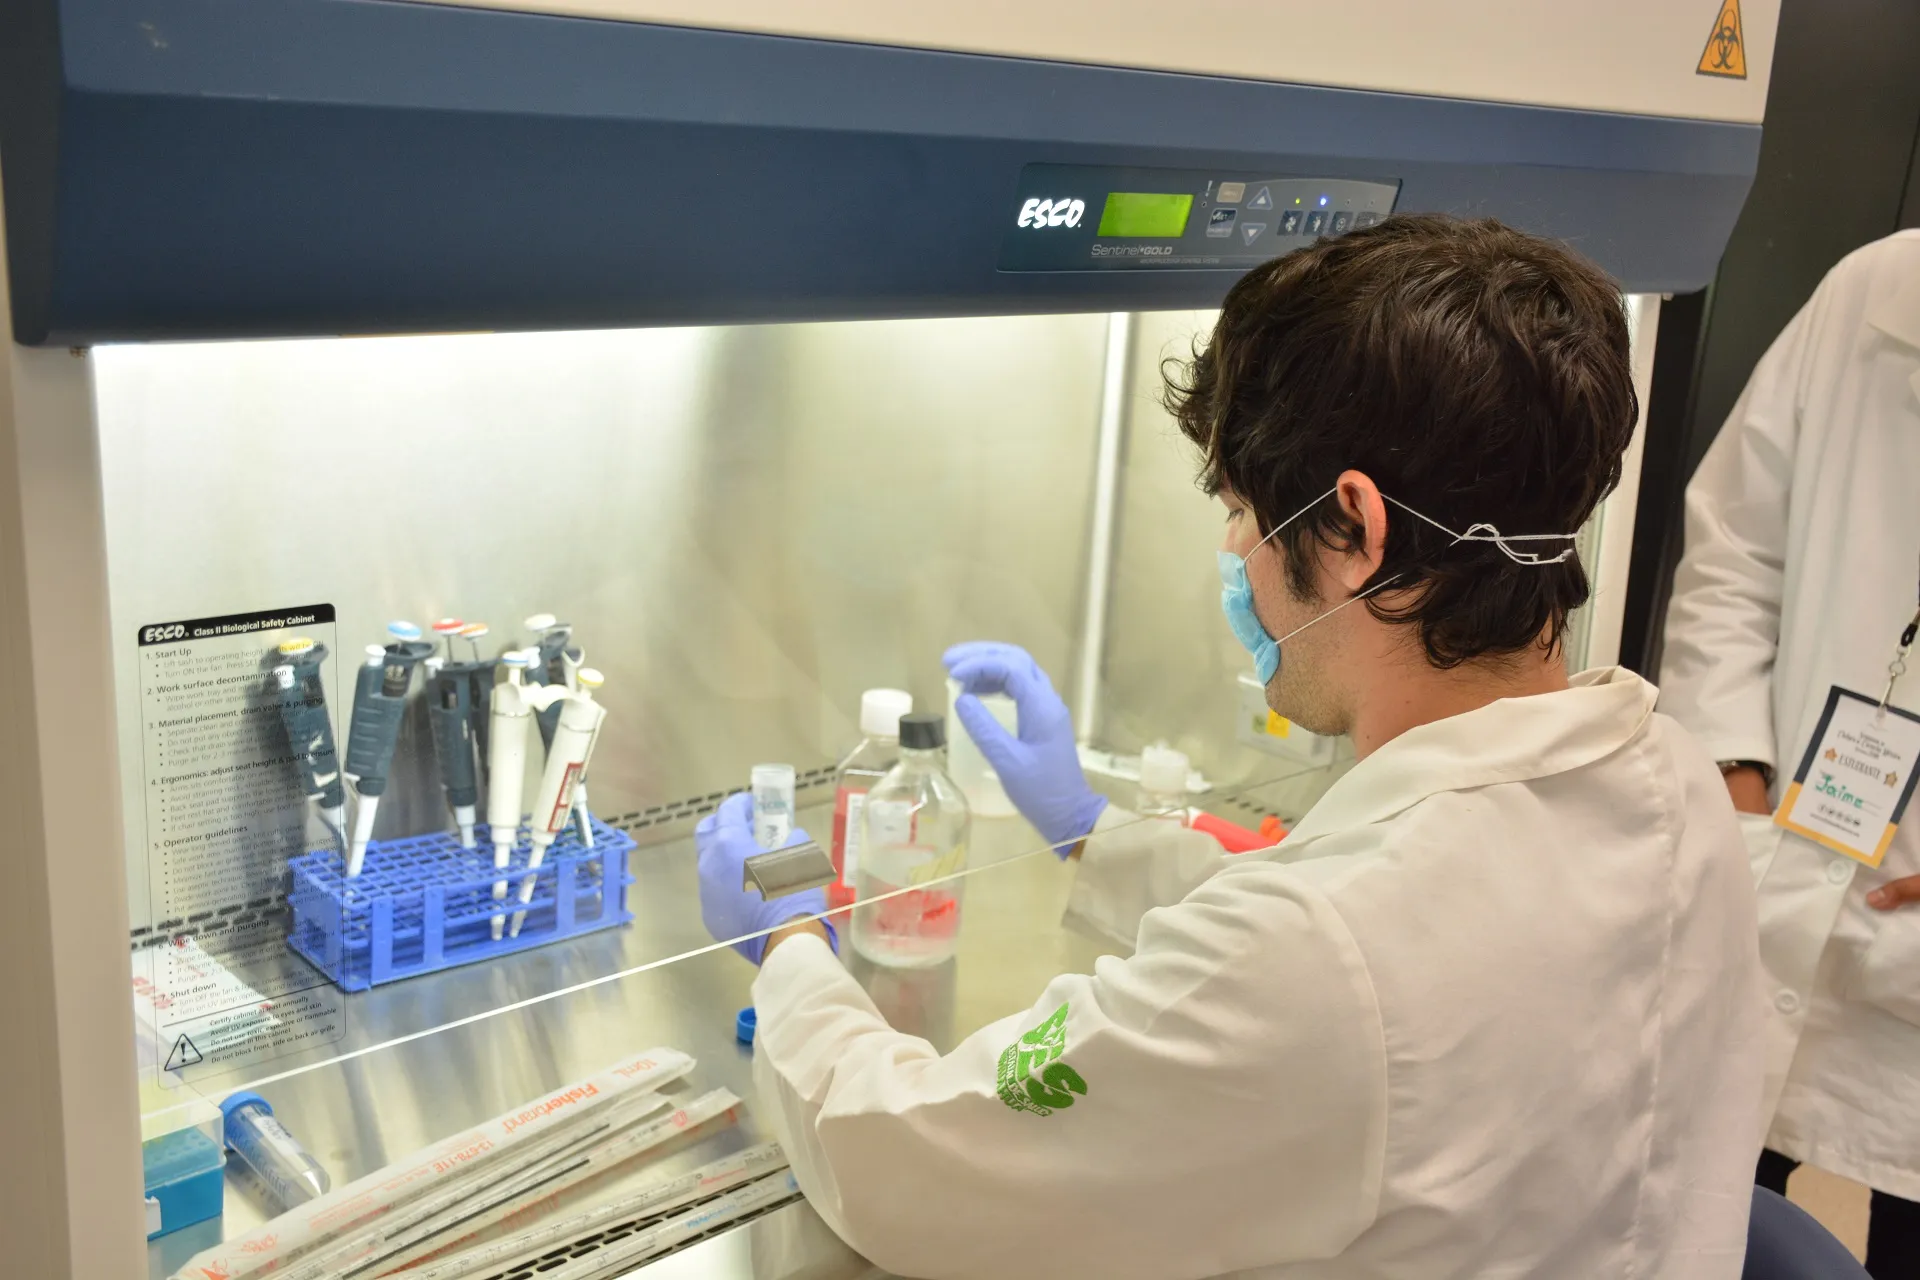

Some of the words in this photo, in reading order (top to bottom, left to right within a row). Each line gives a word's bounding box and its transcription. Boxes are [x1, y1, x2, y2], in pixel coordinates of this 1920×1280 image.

[194, 626, 214, 637] Class
[215, 625, 220, 634] II
[222, 620, 259, 635] Biological
[261, 617, 285, 630] Safety
[286, 614, 315, 625] Cabinet
[145, 652, 152, 661] 1.
[155, 649, 176, 660] Start
[179, 647, 192, 658] Up
[195, 656, 203, 664] to
[205, 651, 239, 664] operating
[165, 669, 181, 678] Turn
[182, 667, 194, 676] ON
[196, 665, 208, 674] the
[146, 686, 154, 695] 2.
[156, 682, 180, 694] Work
[182, 678, 214, 690] surface
[216, 668, 286, 686] decontamination
[165, 692, 185, 703] Wipe
[186, 690, 203, 699] work
[207, 687, 220, 697] tray
[222, 685, 236, 694] and
[158, 715, 193, 728] Material
[194, 708, 238, 724] placement,
[240, 705, 261, 716] drain
[263, 701, 283, 712] valve
[285, 700, 291, 709] &
[293, 695, 322, 709] purging
[166, 701, 193, 712] alcohol
[203, 697, 223, 707] other
[167, 725, 198, 737] Separate
[199, 722, 217, 731] clean
[219, 719, 233, 728] and
[167, 738, 178, 747] Do
[180, 736, 191, 745] not
[194, 733, 206, 744] put
[208, 733, 220, 741] any
[168, 746, 189, 757] Check
[192, 743, 206, 753] that
[208, 740, 225, 750] drain
[151, 777, 158, 786] 4.
[160, 769, 208, 786] Ergonomics:
[210, 764, 233, 777] adjust
[235, 761, 250, 771] seat
[252, 757, 276, 770] height
[278, 756, 284, 764] &
[286, 753, 300, 764] pad
[301, 751, 309, 760] to
[168, 756, 190, 768] Purge
[200, 752, 210, 761] for
[203, 772, 245, 788] comfortably
[170, 792, 190, 802] Avoid
[1815, 772, 1865, 809] Jaime
[170, 802, 186, 812] Back
[189, 799, 203, 809] seat
[205, 796, 219, 807] pad
[220, 790, 250, 804] supports
[170, 812, 186, 822] Feet
[187, 809, 201, 819] rest
[202, 807, 214, 816] flat
[215, 804, 229, 813] and
[171, 823, 176, 832] If
[178, 820, 195, 830] chair
[197, 815, 222, 828] setting
[223, 813, 228, 822] is
[162, 832, 203, 849] Operator
[204, 823, 248, 841] guidelines
[171, 846, 189, 856] Wear
[172, 866, 183, 875] Do
[184, 863, 195, 872] not
[196, 859, 213, 870] block
[174, 904, 185, 913] Put
[167, 935, 190, 949] Wipe
[192, 929, 216, 942] down
[218, 925, 234, 936] and
[236, 917, 269, 933] purging
[169, 987, 190, 999] Shut
[192, 980, 216, 993] down
[209, 1014, 231, 1028] Certify
[233, 1008, 256, 1021] cabinet
[258, 1005, 264, 1014] at
[265, 1001, 281, 1012] least
[282, 994, 308, 1009] annually
[210, 1025, 229, 1036] Avoid
[230, 1022, 241, 1031] UV
[242, 1015, 270, 1029] exposure
[273, 1011, 280, 1019] to
[281, 1009, 294, 1018] eyes
[296, 1004, 308, 1013] and
[309, 1000, 321, 1010] skin
[210, 1037, 220, 1046] Do
[221, 1034, 232, 1043] not
[265, 1017, 294, 1032] explosive
[304, 1006, 336, 1020] flammable
[210, 1038, 245, 1054] substances
[247, 1036, 253, 1044] in
[254, 1032, 266, 1042] this
[268, 1025, 291, 1038] cabinet
[211, 1054, 221, 1063] Do
[222, 1051, 233, 1060] not
[235, 1046, 251, 1057] block
[252, 1041, 270, 1053] front,
[272, 1037, 285, 1046] side
[294, 1030, 308, 1040] back
[310, 1028, 318, 1036] air
[319, 1023, 336, 1034] grille
